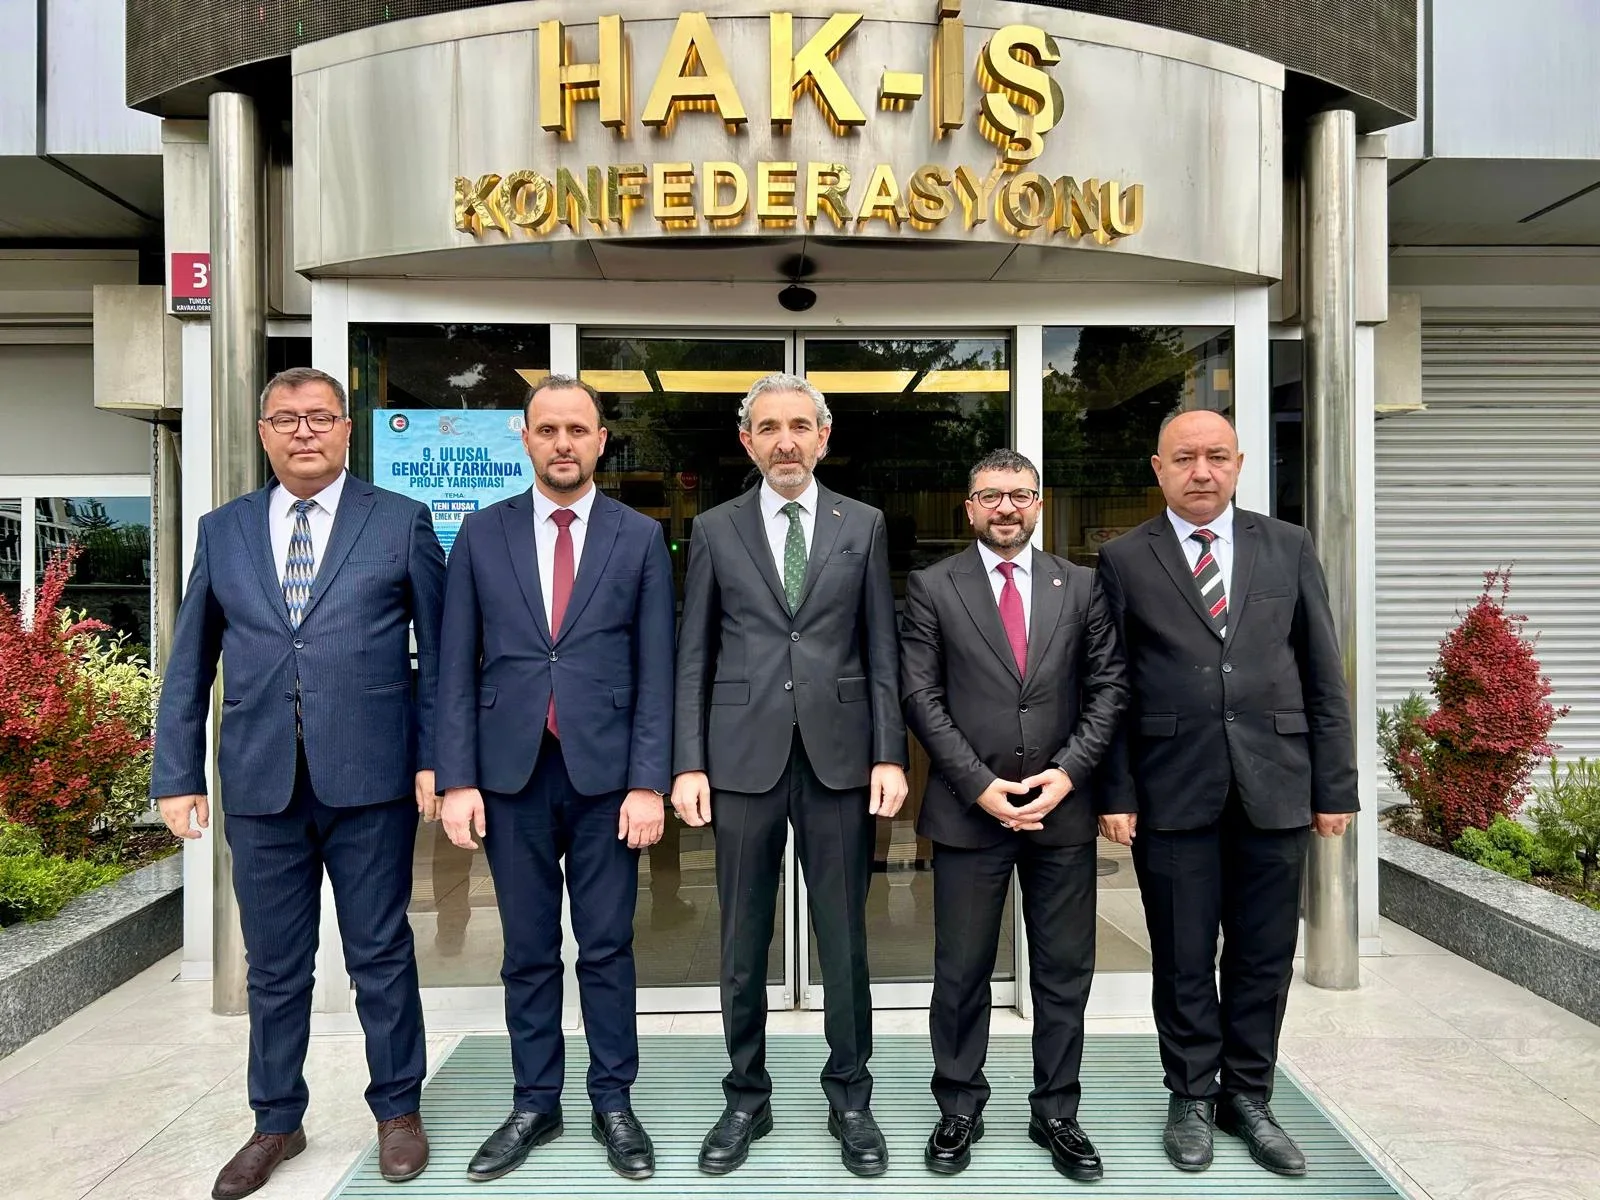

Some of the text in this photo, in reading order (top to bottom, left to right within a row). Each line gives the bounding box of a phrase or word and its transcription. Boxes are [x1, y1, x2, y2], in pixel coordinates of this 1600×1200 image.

[538, 0, 1065, 166] HAK-İŞ
[453, 160, 1145, 241] KONFEDERASYONU
[193, 263, 210, 288] 3
[422, 447, 491, 462] 9. ULUSAL
[453, 462, 522, 477] FARKINDA
[409, 477, 505, 490] PROJE YARIŞMASI
[451, 502, 475, 512] KUŞAK
[434, 512, 462, 521] EMEK VE
